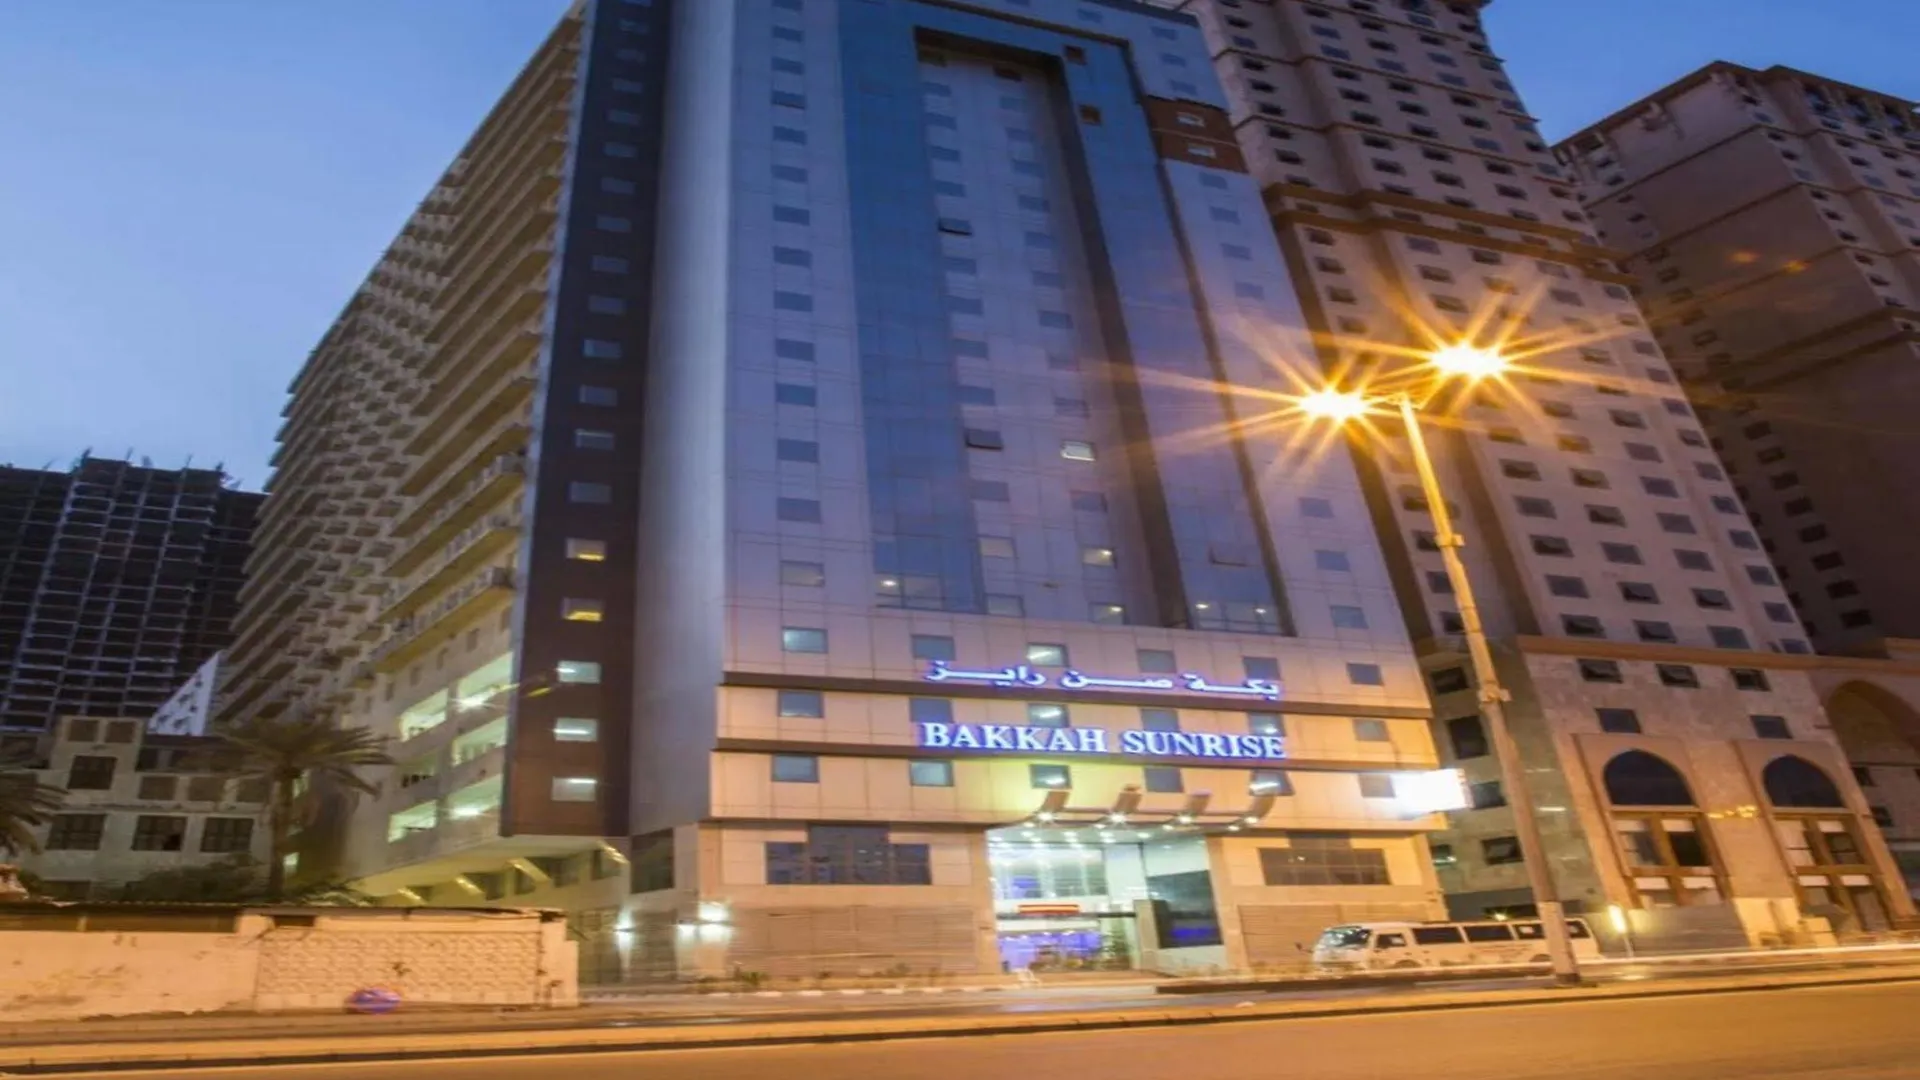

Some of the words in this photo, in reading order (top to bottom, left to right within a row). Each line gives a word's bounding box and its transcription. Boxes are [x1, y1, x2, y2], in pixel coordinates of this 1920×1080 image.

[926, 660, 1047, 687] رايز
[1061, 670, 1173, 689] صن
[1181, 673, 1280, 700] بكة
[923, 722, 1108, 752] BAKKAH
[1123, 730, 1286, 758] SUNRISE
